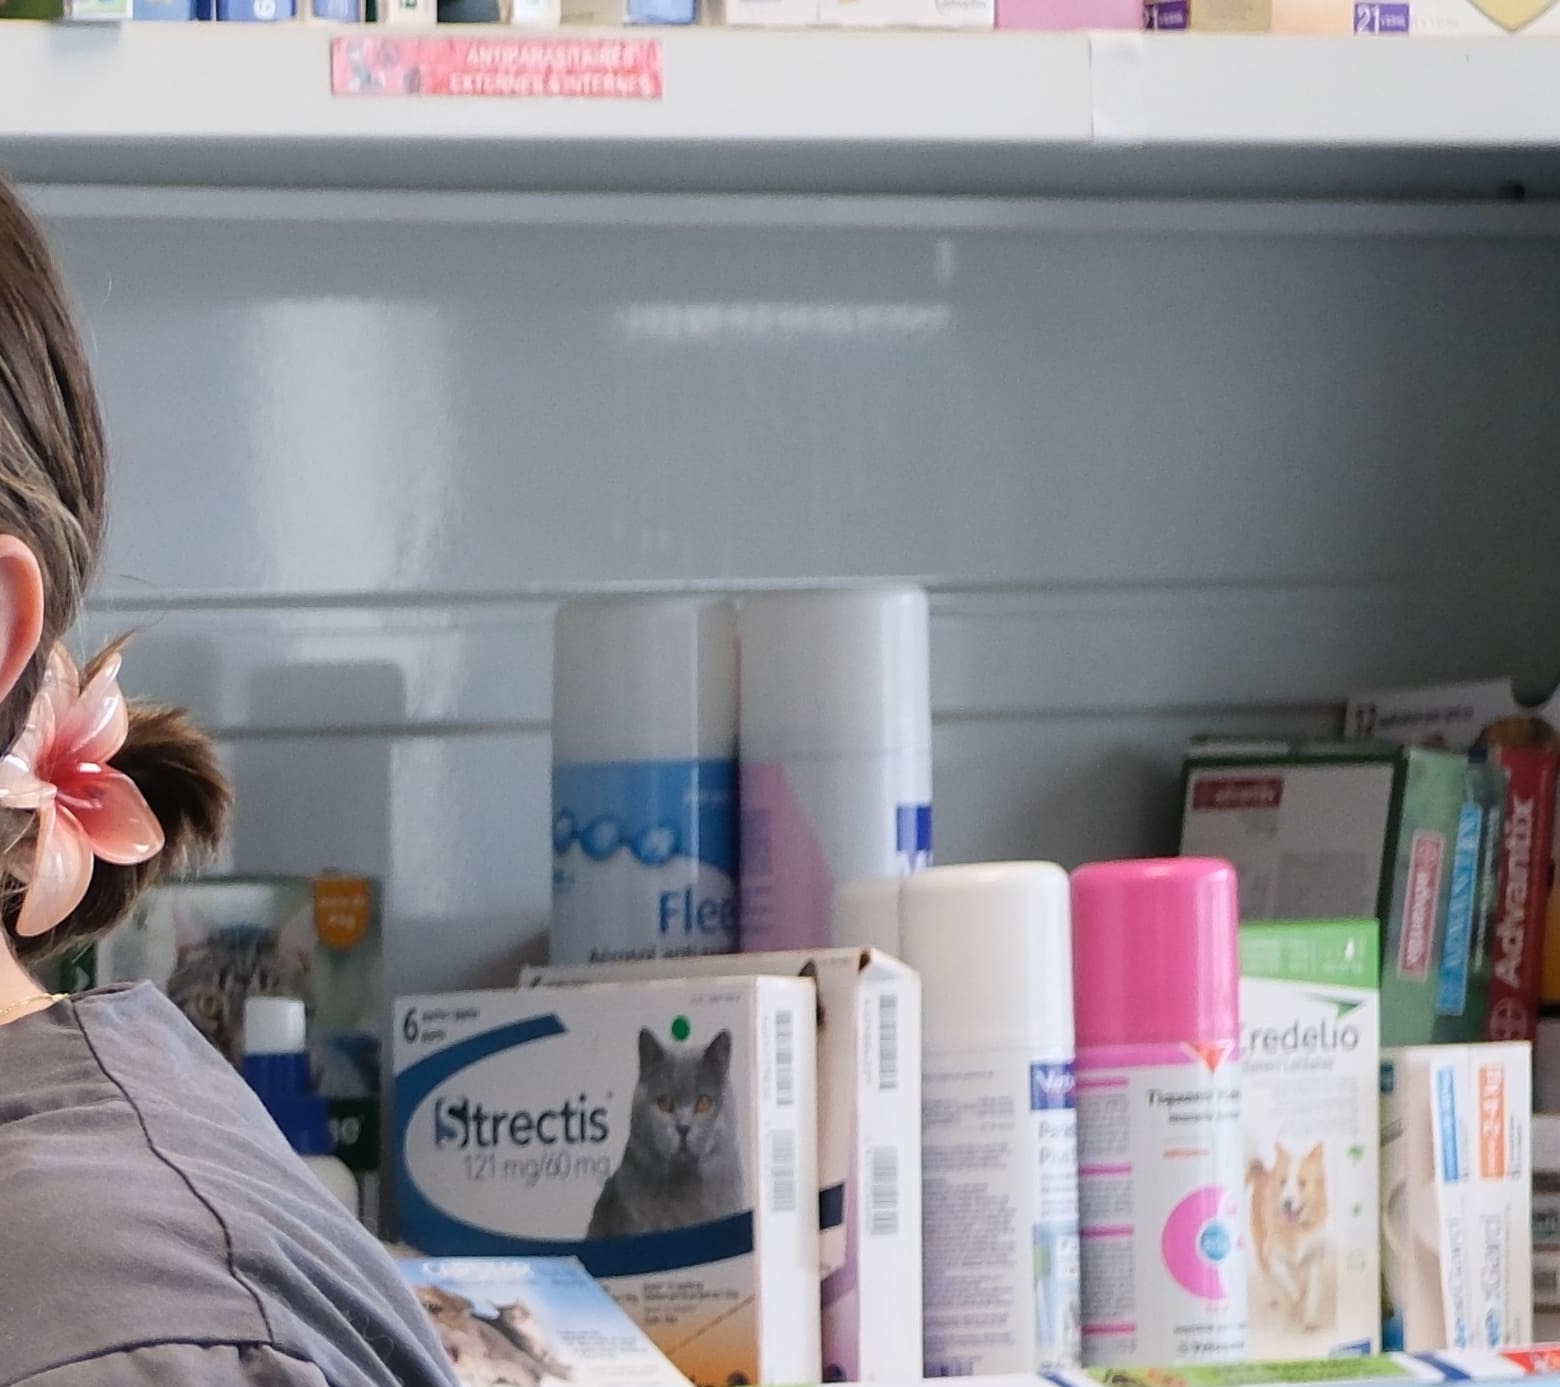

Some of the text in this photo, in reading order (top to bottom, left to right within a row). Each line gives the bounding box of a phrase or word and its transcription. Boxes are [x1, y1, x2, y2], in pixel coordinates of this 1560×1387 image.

[465, 42, 637, 67] ANTIPARASITAIRES
[402, 1007, 420, 1042] 6
[1242, 1020, 1360, 1054] redelio
[433, 1092, 610, 1152] Strectis
